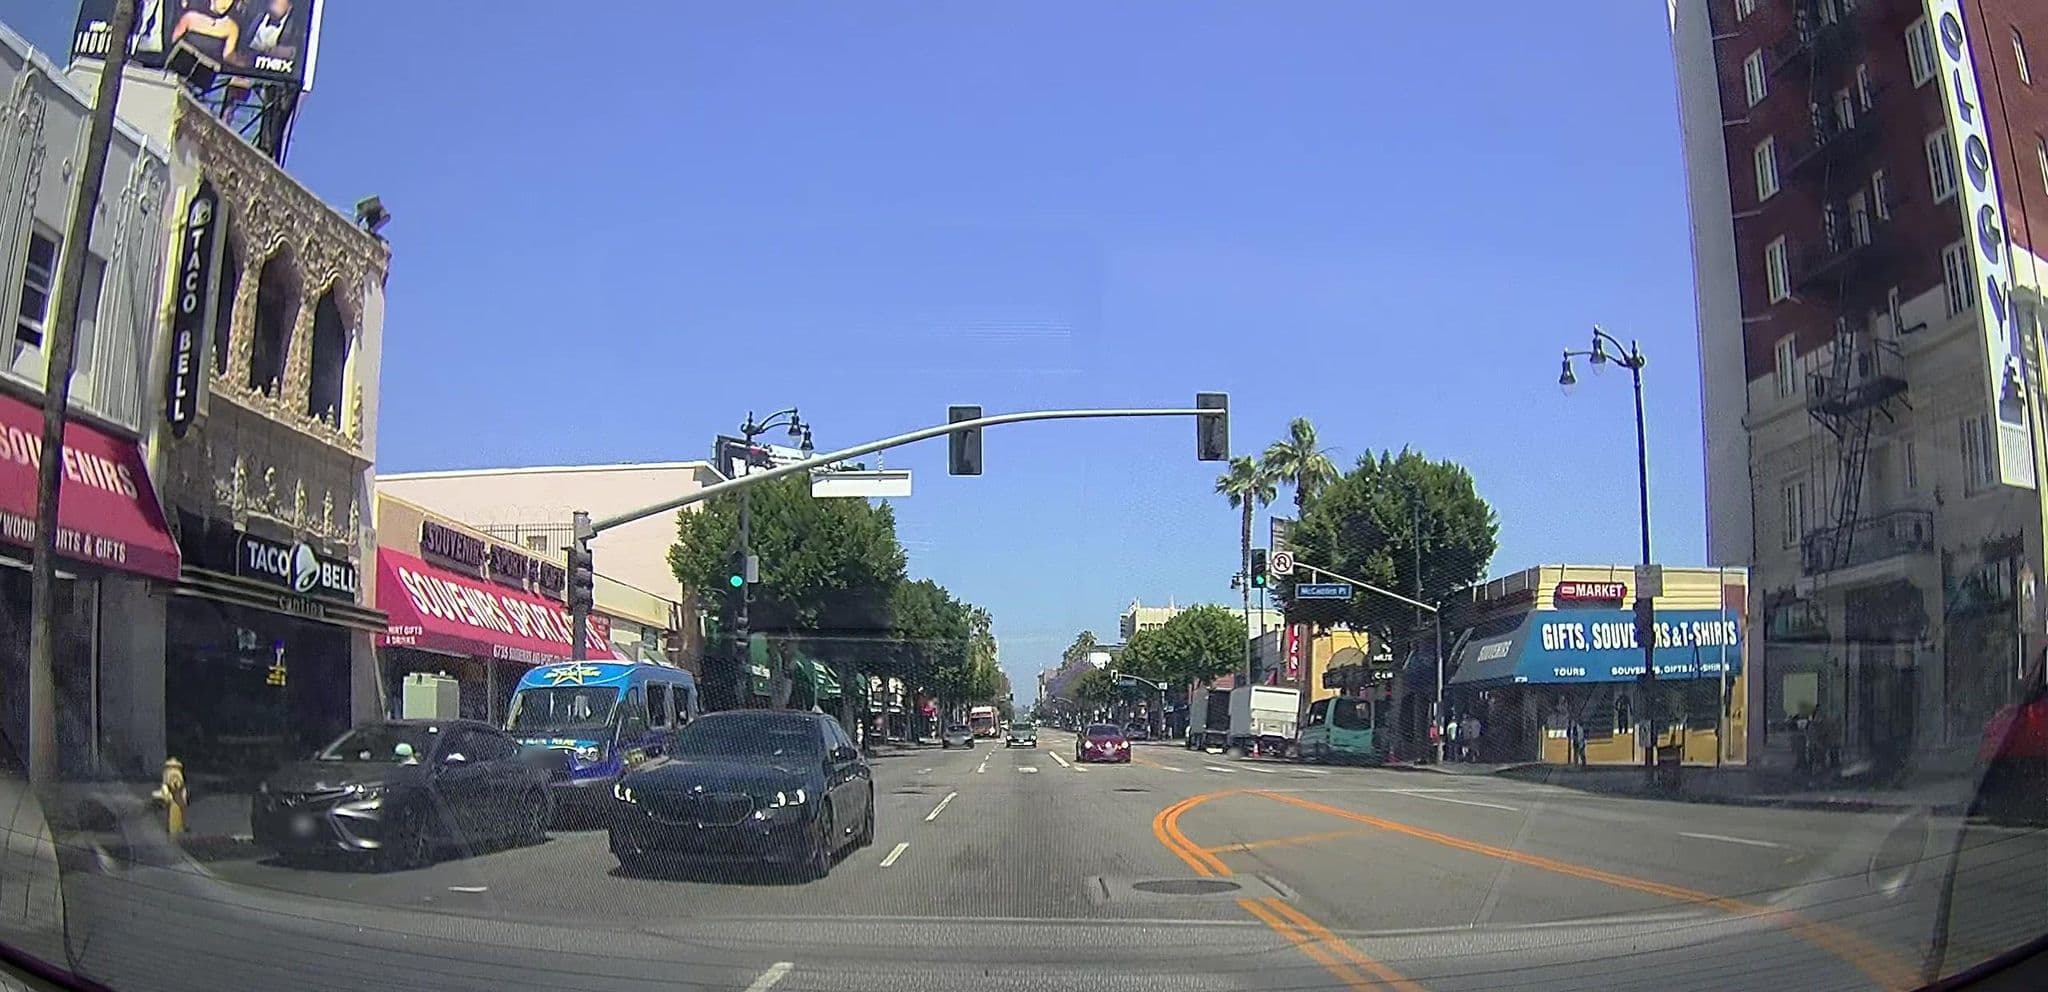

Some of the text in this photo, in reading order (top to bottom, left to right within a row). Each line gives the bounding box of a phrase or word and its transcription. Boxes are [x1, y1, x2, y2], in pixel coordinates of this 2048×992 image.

[255, 55, 294, 73] max
[173, 229, 204, 422] TACO BELL
[0, 424, 138, 500] SOUENIRS
[0, 511, 36, 542] WOOD
[95, 536, 126, 563] GIFTS
[246, 540, 355, 592] TACO BELL
[1575, 583, 1622, 597] MARKET
[397, 566, 514, 634] SOUVENIRS
[1542, 622, 1590, 652] GIFTS,
[1591, 621, 1671, 649] SOUVERS
[1553, 667, 1586, 676] TOURS
